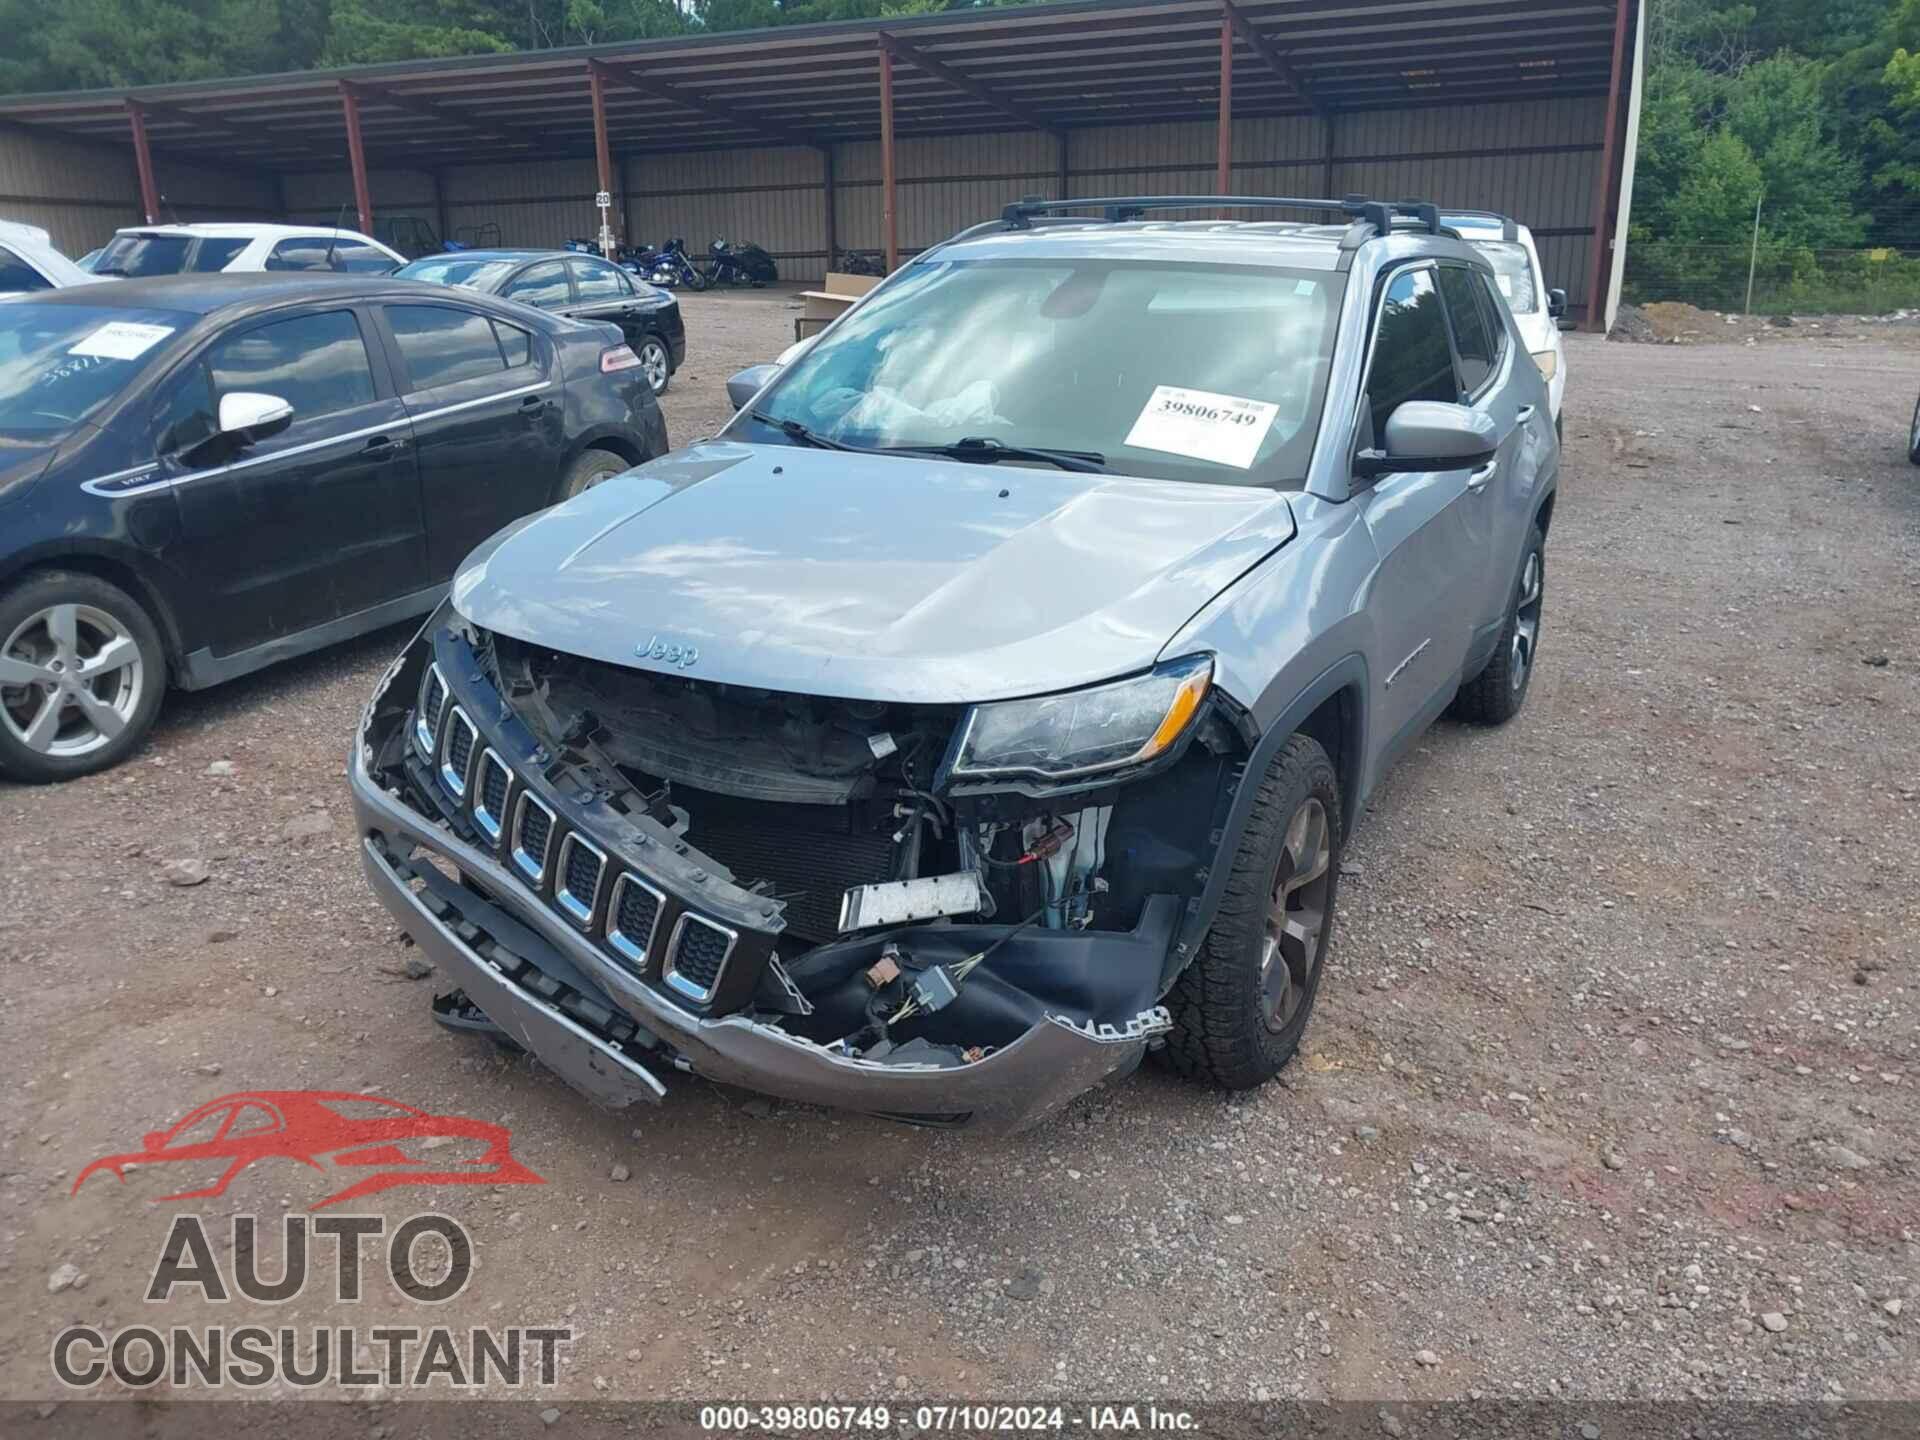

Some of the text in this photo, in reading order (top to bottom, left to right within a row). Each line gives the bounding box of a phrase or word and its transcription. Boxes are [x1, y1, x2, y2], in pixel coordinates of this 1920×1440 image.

[596, 194, 609, 204] 20
[1158, 400, 1257, 426] 39806749
[633, 634, 699, 669] Jeep
